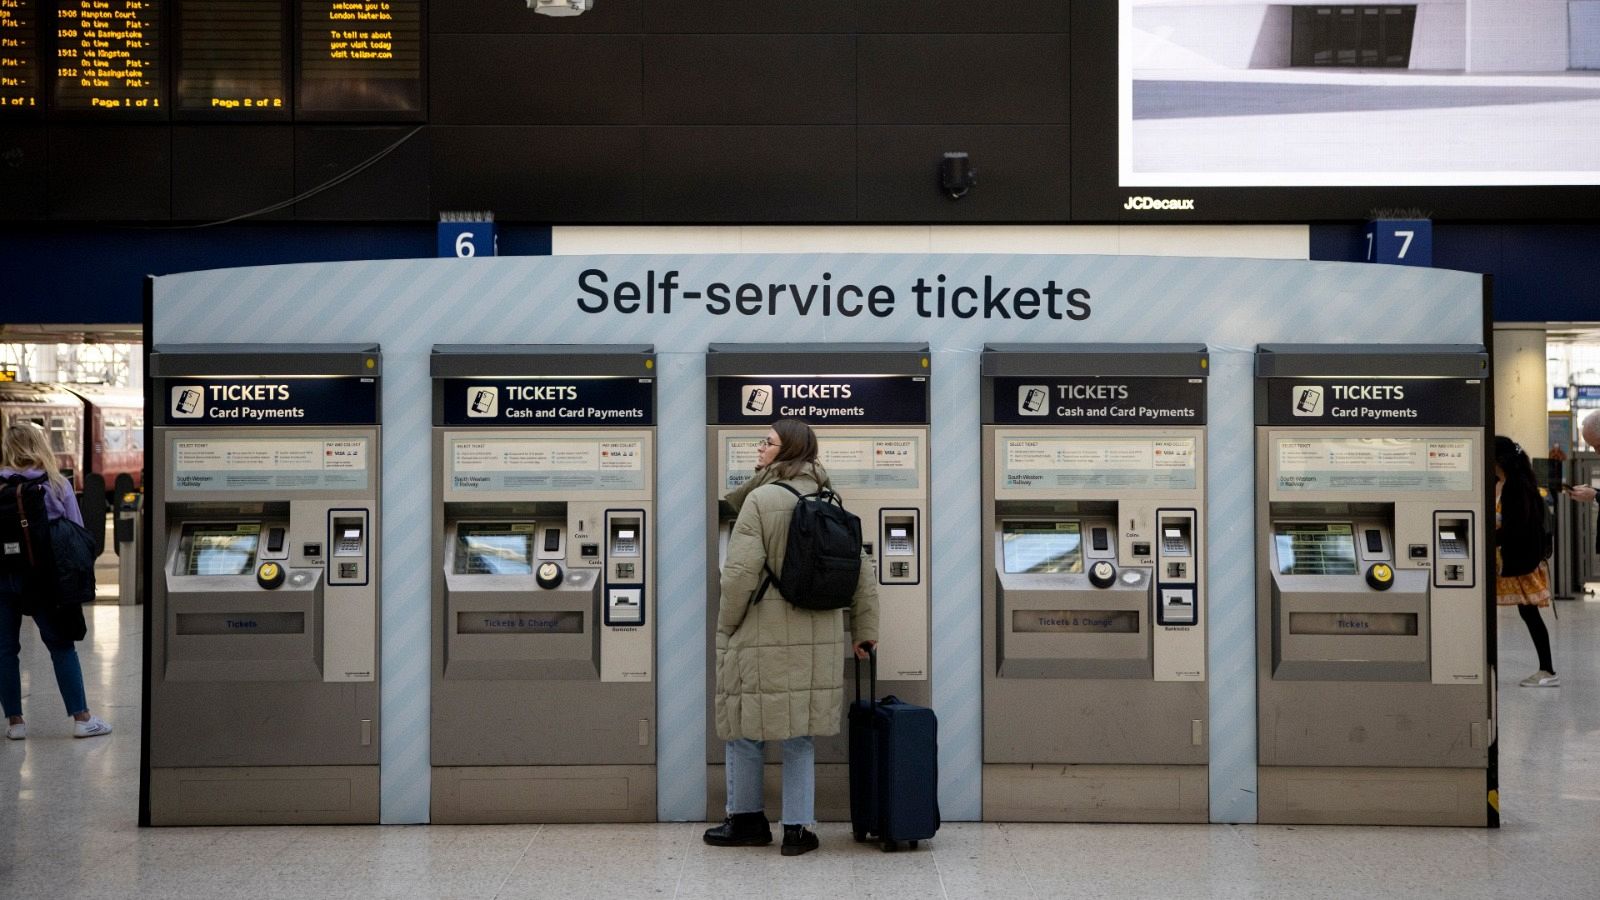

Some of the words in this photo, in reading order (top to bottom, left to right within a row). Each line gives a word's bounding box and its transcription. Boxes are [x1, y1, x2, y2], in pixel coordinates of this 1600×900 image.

[81, 11, 112, 19] Hampton
[2, 19, 18, 27] Plat
[84, 30, 95, 38] via
[98, 30, 142, 39] Basingstoke
[331, 42, 348, 50] your
[370, 41, 391, 50] today
[98, 50, 130, 58] Kingston
[331, 50, 348, 58] visit
[2, 58, 18, 66] Plat
[98, 69, 142, 78] Basingstoke
[2, 77, 18, 86] Plat
[12, 97, 24, 105] of
[30, 97, 36, 106] 1
[92, 98, 120, 107] Page
[126, 98, 130, 106] 1
[136, 98, 148, 106] of
[154, 98, 159, 106] 1
[212, 98, 240, 108] Page
[244, 98, 252, 107] 2
[256, 98, 268, 107] of
[274, 98, 282, 107] 2
[1124, 196, 1194, 211] JCDecaux
[455, 231, 475, 258] 6
[1394, 230, 1414, 259] 7
[576, 268, 895, 317] Self-service
[912, 274, 1091, 320] tickets
[209, 385, 290, 401] TICKETS
[506, 386, 577, 401] TICKETS
[780, 384, 851, 399] TICKETS
[1057, 385, 1128, 399] TICKETS
[1332, 386, 1404, 400] TICKETS
[210, 407, 239, 418] Card
[242, 407, 304, 420] Payments
[505, 407, 533, 418] Cash
[535, 407, 556, 418] and
[558, 407, 584, 418] Card
[587, 407, 643, 420] Payments
[780, 406, 806, 417] Card
[809, 406, 864, 418] Payments
[1057, 406, 1084, 417] Cash
[1086, 406, 1108, 417] and
[1110, 406, 1136, 417] Card
[1139, 407, 1195, 419] Payments
[1332, 407, 1358, 418] Card
[1361, 407, 1417, 419] Payments
[227, 620, 257, 628] Tickets
[484, 619, 515, 627] Tickets
[528, 619, 559, 629] Change
[1039, 618, 1069, 626] Tickets
[1082, 618, 1113, 628] Change
[1338, 620, 1369, 628] Tickets
